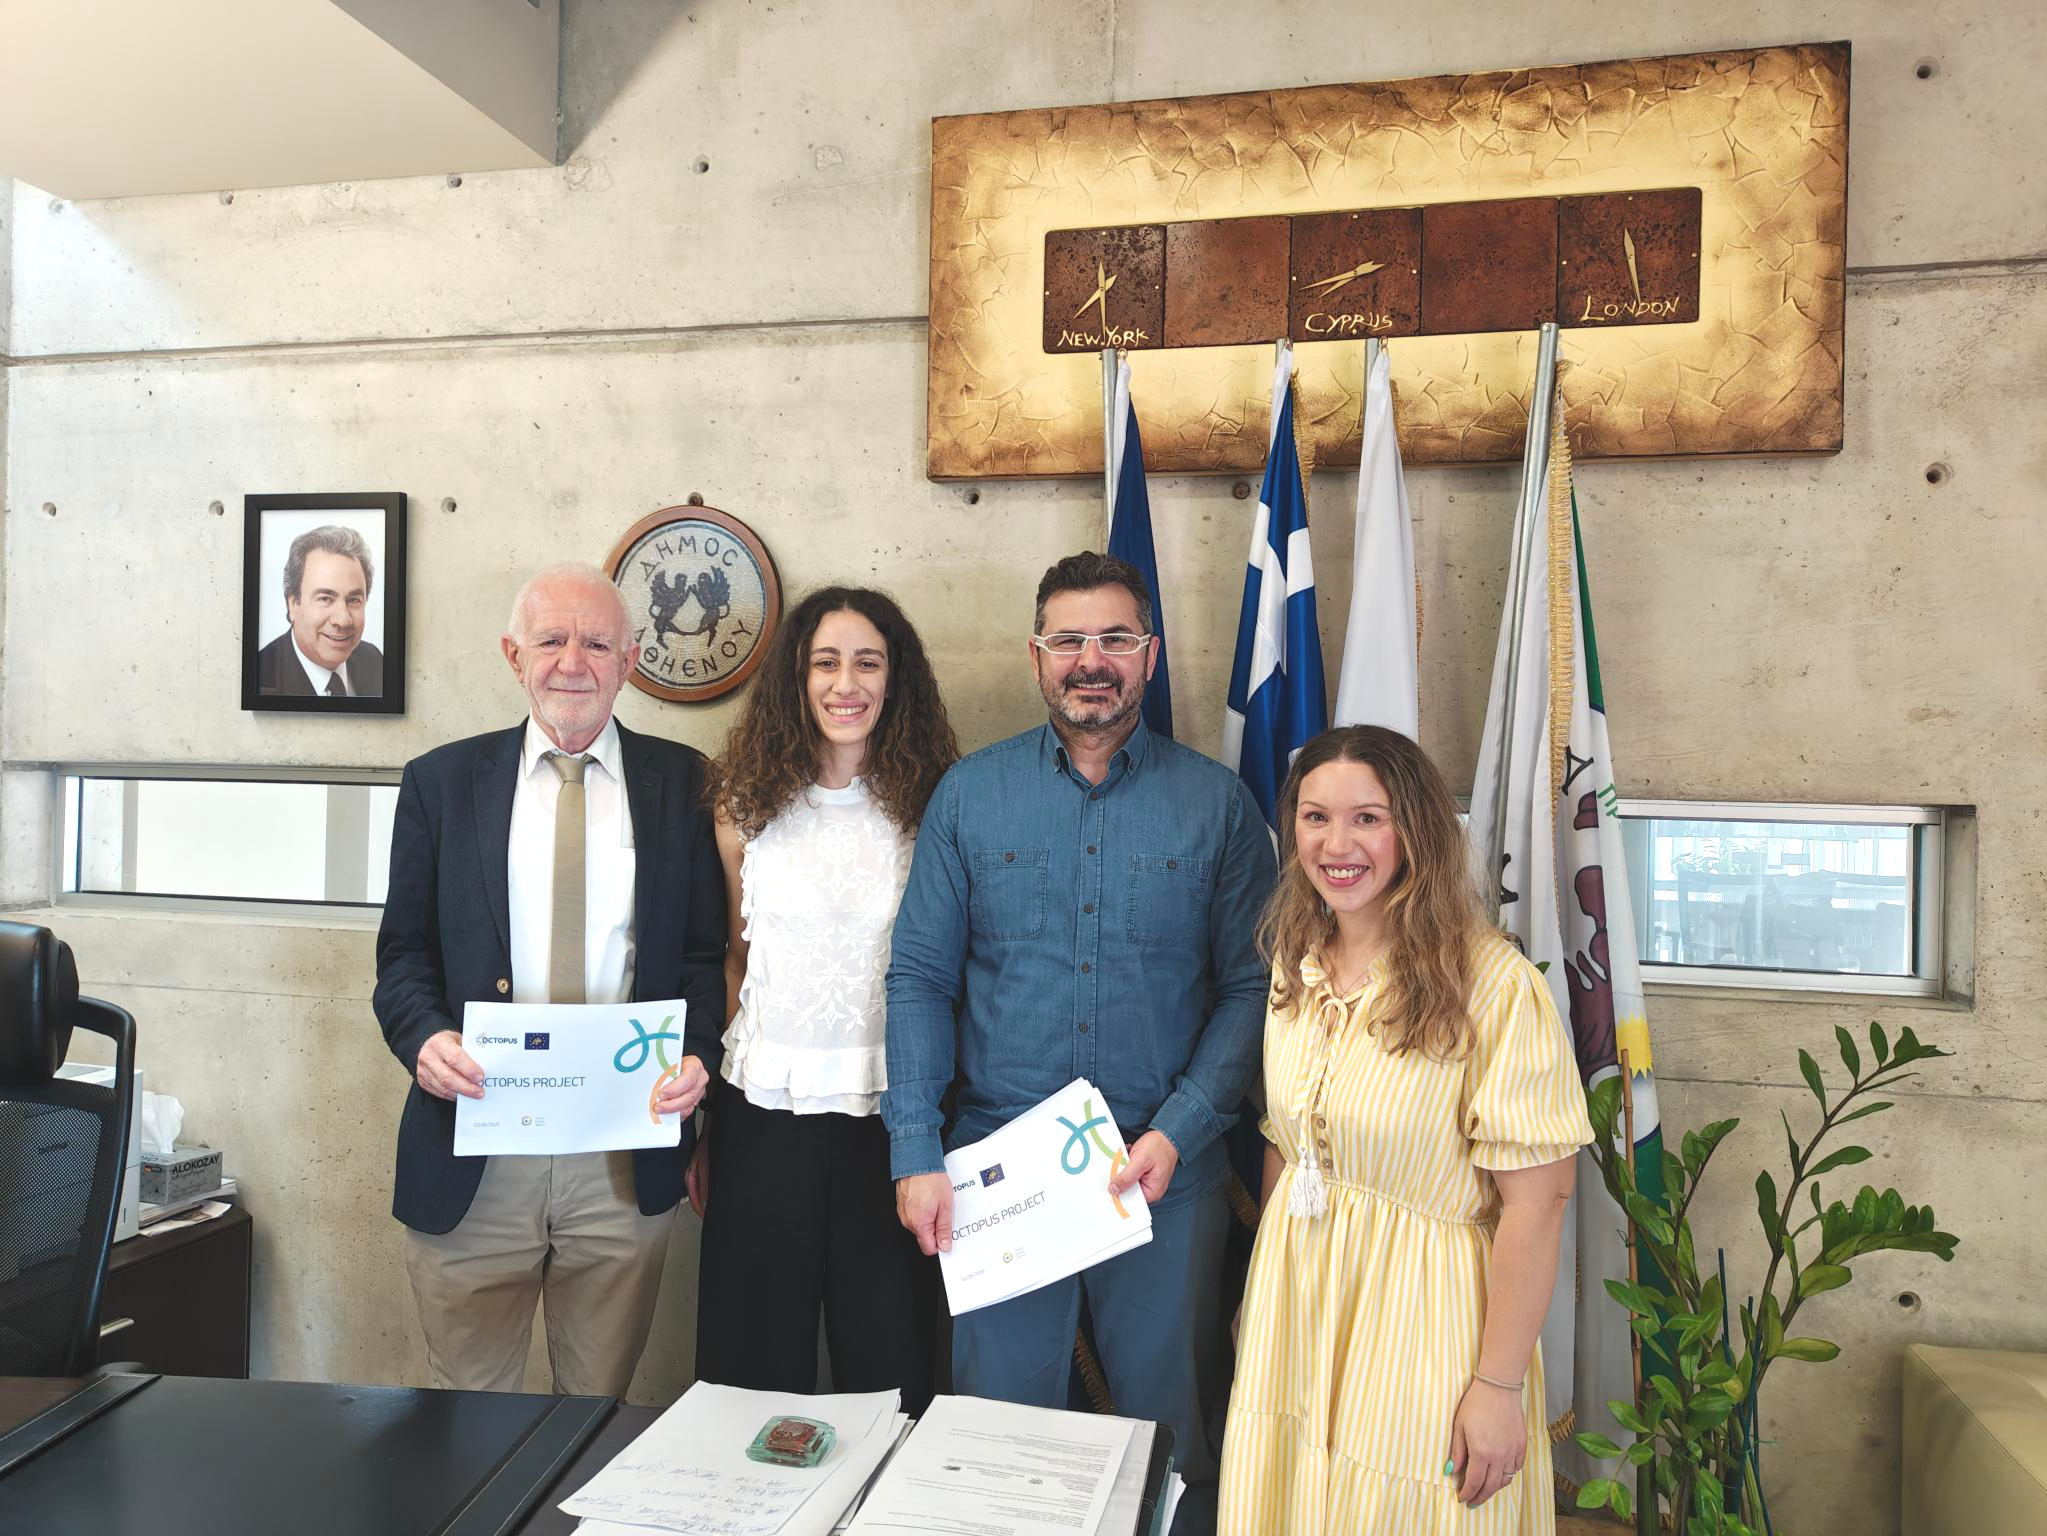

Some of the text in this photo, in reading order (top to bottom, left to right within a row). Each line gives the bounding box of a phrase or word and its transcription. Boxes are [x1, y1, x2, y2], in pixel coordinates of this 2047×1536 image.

[1580, 295, 1680, 321] LONDON
[1304, 312, 1393, 333] CYPRUS
[1057, 325, 1150, 347] NEW YORK
[533, 1076, 586, 1087] PROJECT
[172, 1155, 219, 1175] ALOKOZAY
[953, 1179, 975, 1192] TOPUS
[951, 1190, 1045, 1242] OCTOPUS PROJECT
